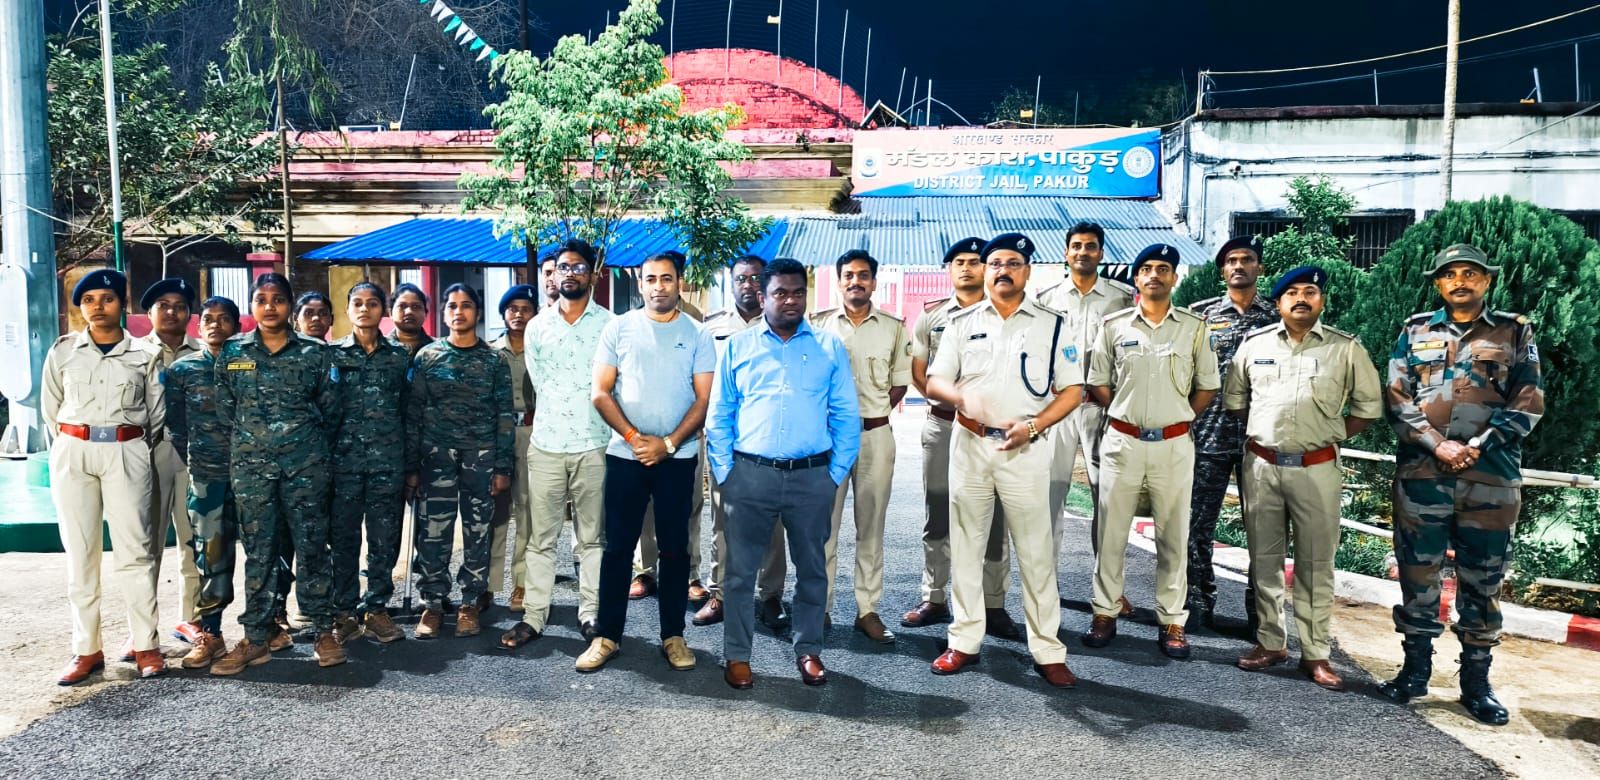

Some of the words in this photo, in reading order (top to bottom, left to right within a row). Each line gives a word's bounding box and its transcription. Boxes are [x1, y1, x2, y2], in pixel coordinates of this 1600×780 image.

[1011, 134, 1055, 146] सरकार
[885, 147, 959, 167] मंडल
[914, 175, 985, 190] DISTRICT
[989, 175, 1029, 191] JAIL,
[1034, 175, 1089, 190] PAKUR
